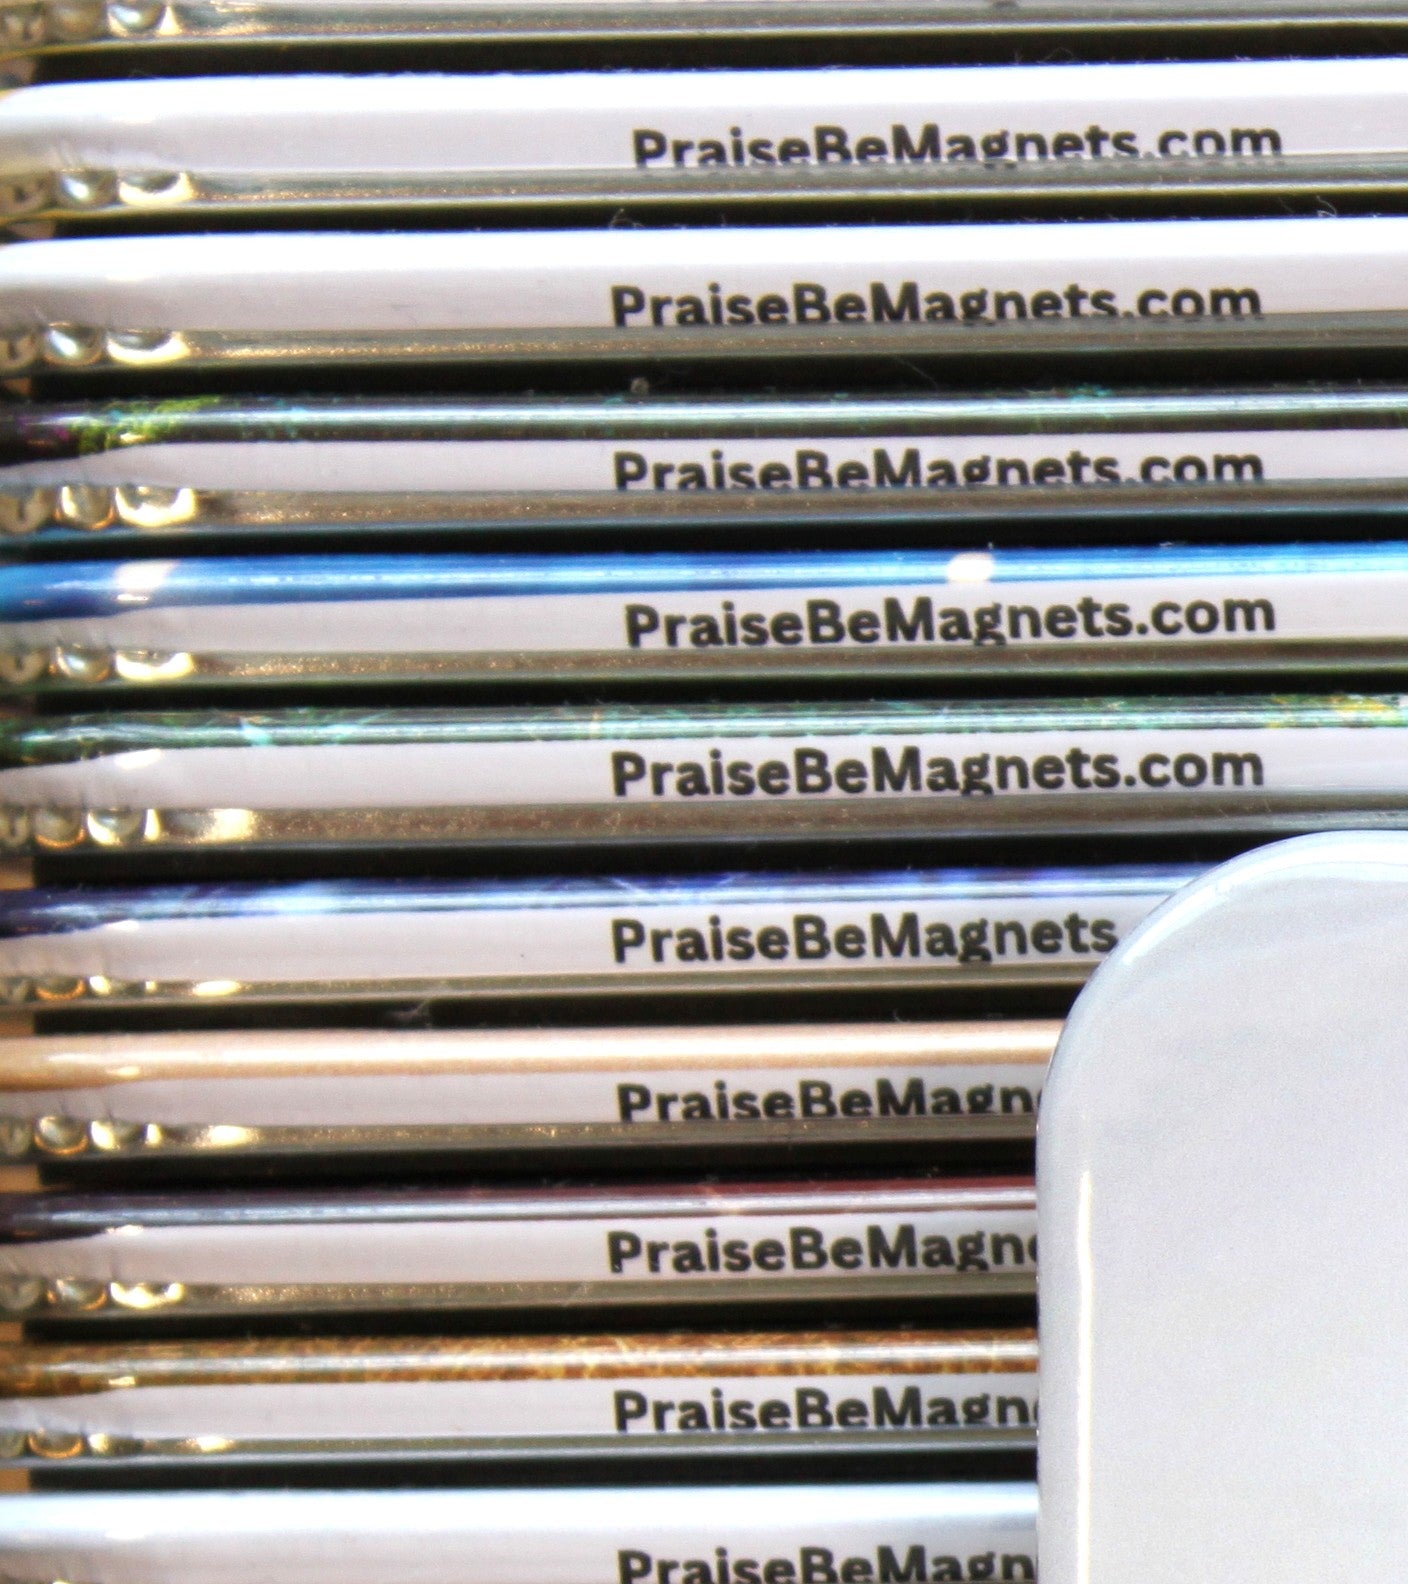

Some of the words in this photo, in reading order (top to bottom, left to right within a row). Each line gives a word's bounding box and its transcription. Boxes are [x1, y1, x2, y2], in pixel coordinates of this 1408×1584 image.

[611, 282, 1262, 329] PraiseBeMagnets.com
[625, 595, 1276, 648] PraiseBeMagnets.com
[611, 744, 1263, 798] PraiseBeMagnets.com
[620, 1081, 1041, 1123] PraiseBeMagn
[608, 1226, 1036, 1273] PraiseBeMagn
[615, 1387, 1038, 1432] PraiseBeMagn
